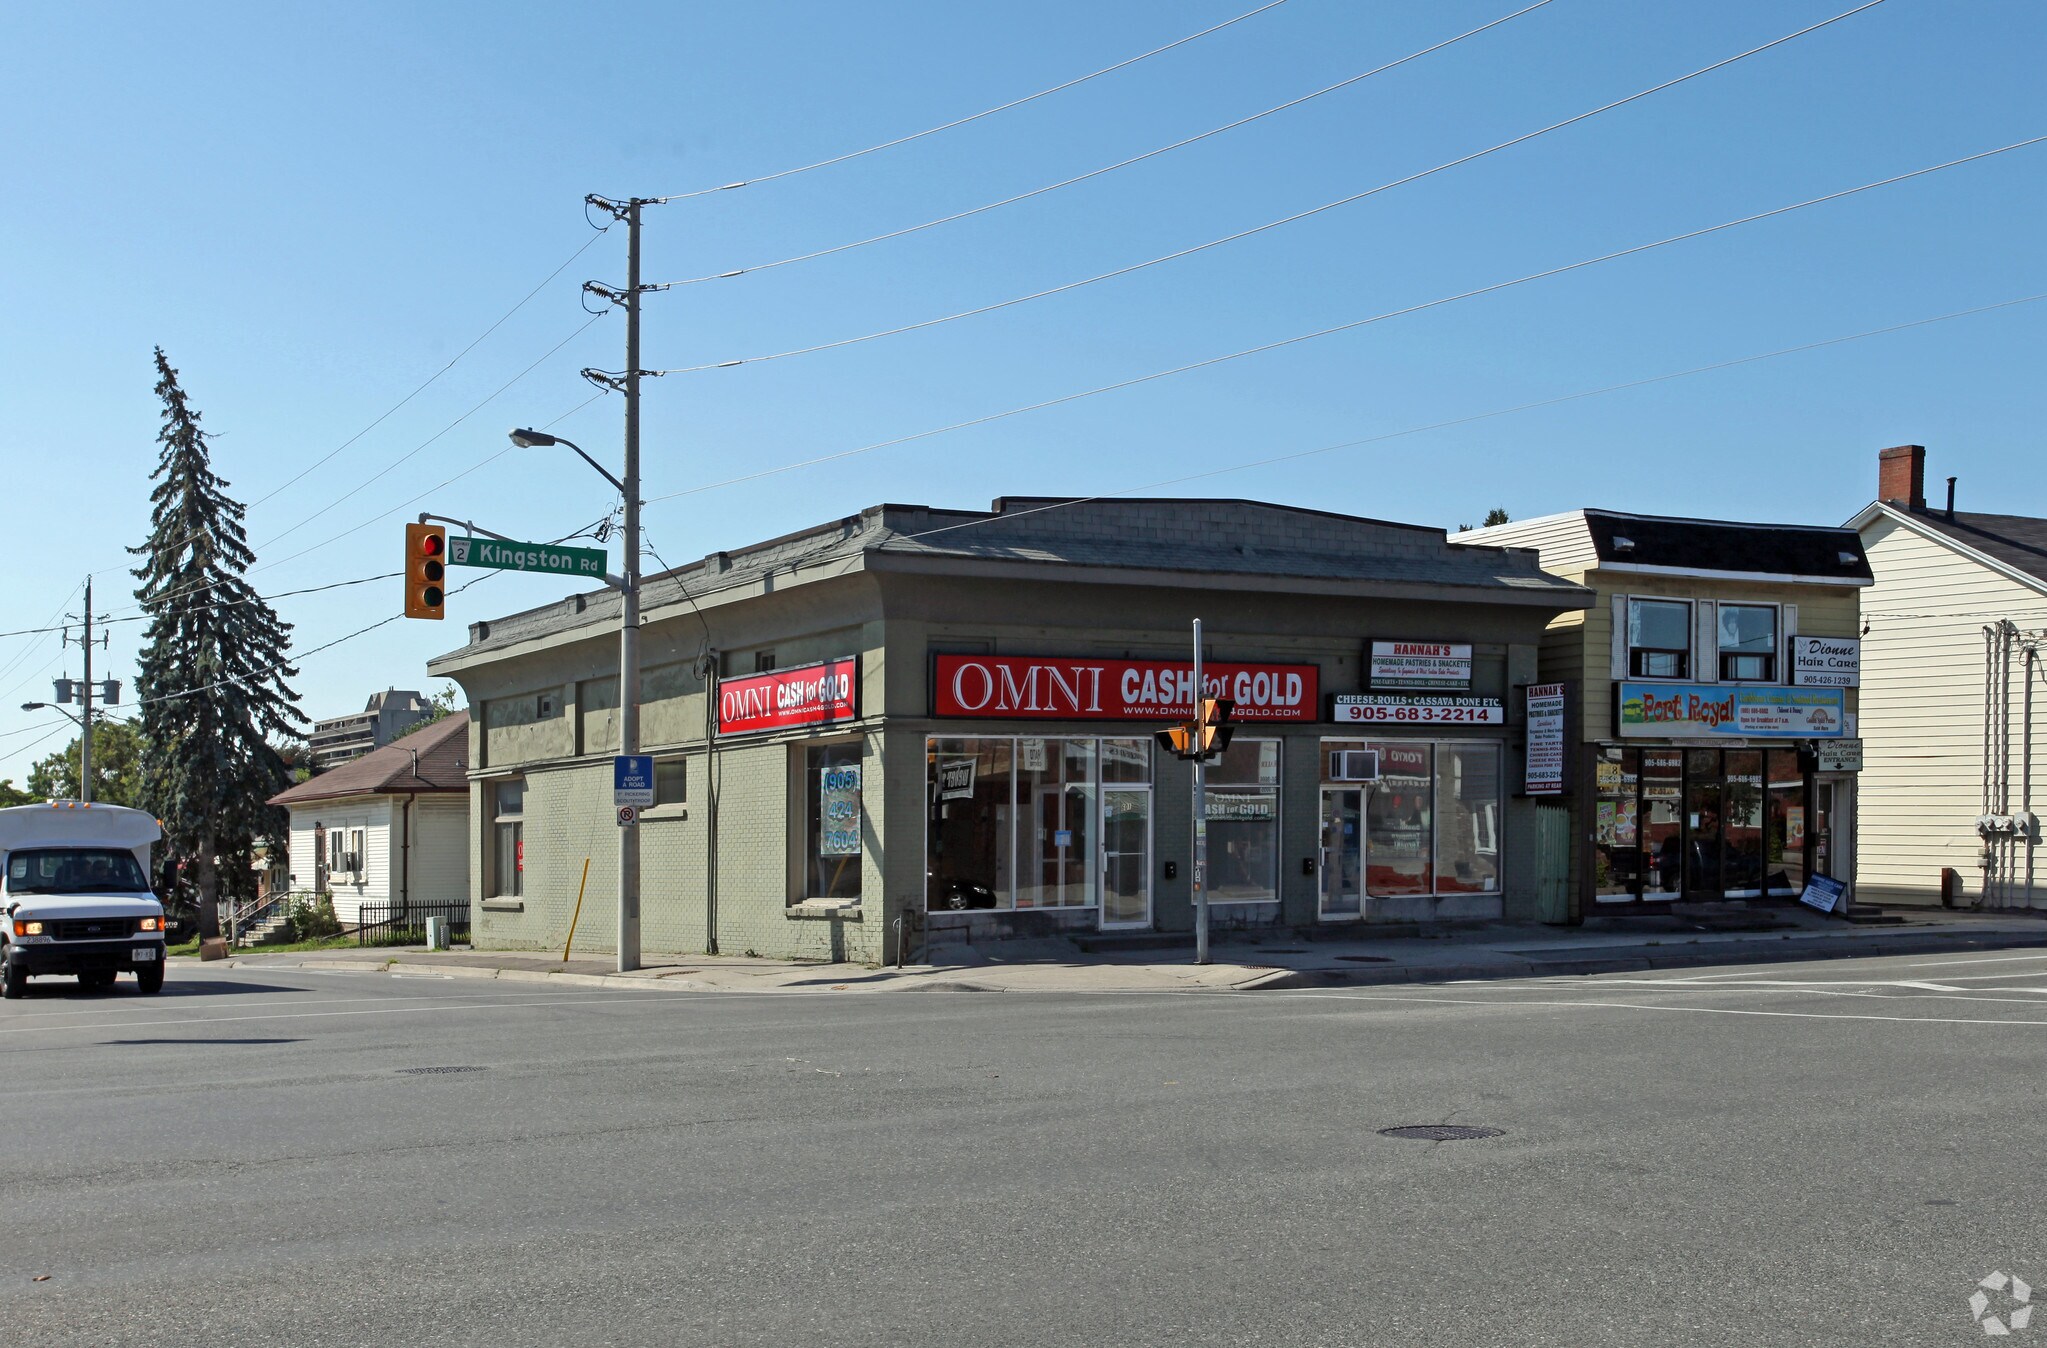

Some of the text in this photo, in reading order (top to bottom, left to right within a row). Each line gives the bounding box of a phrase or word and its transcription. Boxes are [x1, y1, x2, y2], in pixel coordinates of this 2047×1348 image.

[457, 548, 465, 560] 2
[480, 544, 598, 571] Kingston Rd
[1394, 644, 1451, 656] HANNAH'S
[1809, 640, 1854, 655] Dionne
[1373, 658, 1404, 666] HOMEMADE
[1405, 659, 1431, 667] PASTRIES
[1438, 660, 1471, 668] SNACKETTE
[952, 663, 1302, 712] OMNI CASH for GOLD
[1529, 685, 1564, 698] HANNAH'S
[723, 674, 848, 722] OMNI CASH for GOLD
[1337, 695, 1501, 706] CHEESE-ROLLS CASSAVA PONE ETC.
[1644, 693, 1734, 727] Port Royal
[1827, 740, 1859, 748] Dionne
[825, 771, 857, 794] (905)
[829, 801, 852, 818] 424
[1240, 804, 1268, 814] GOLD
[825, 830, 857, 848] 7604
